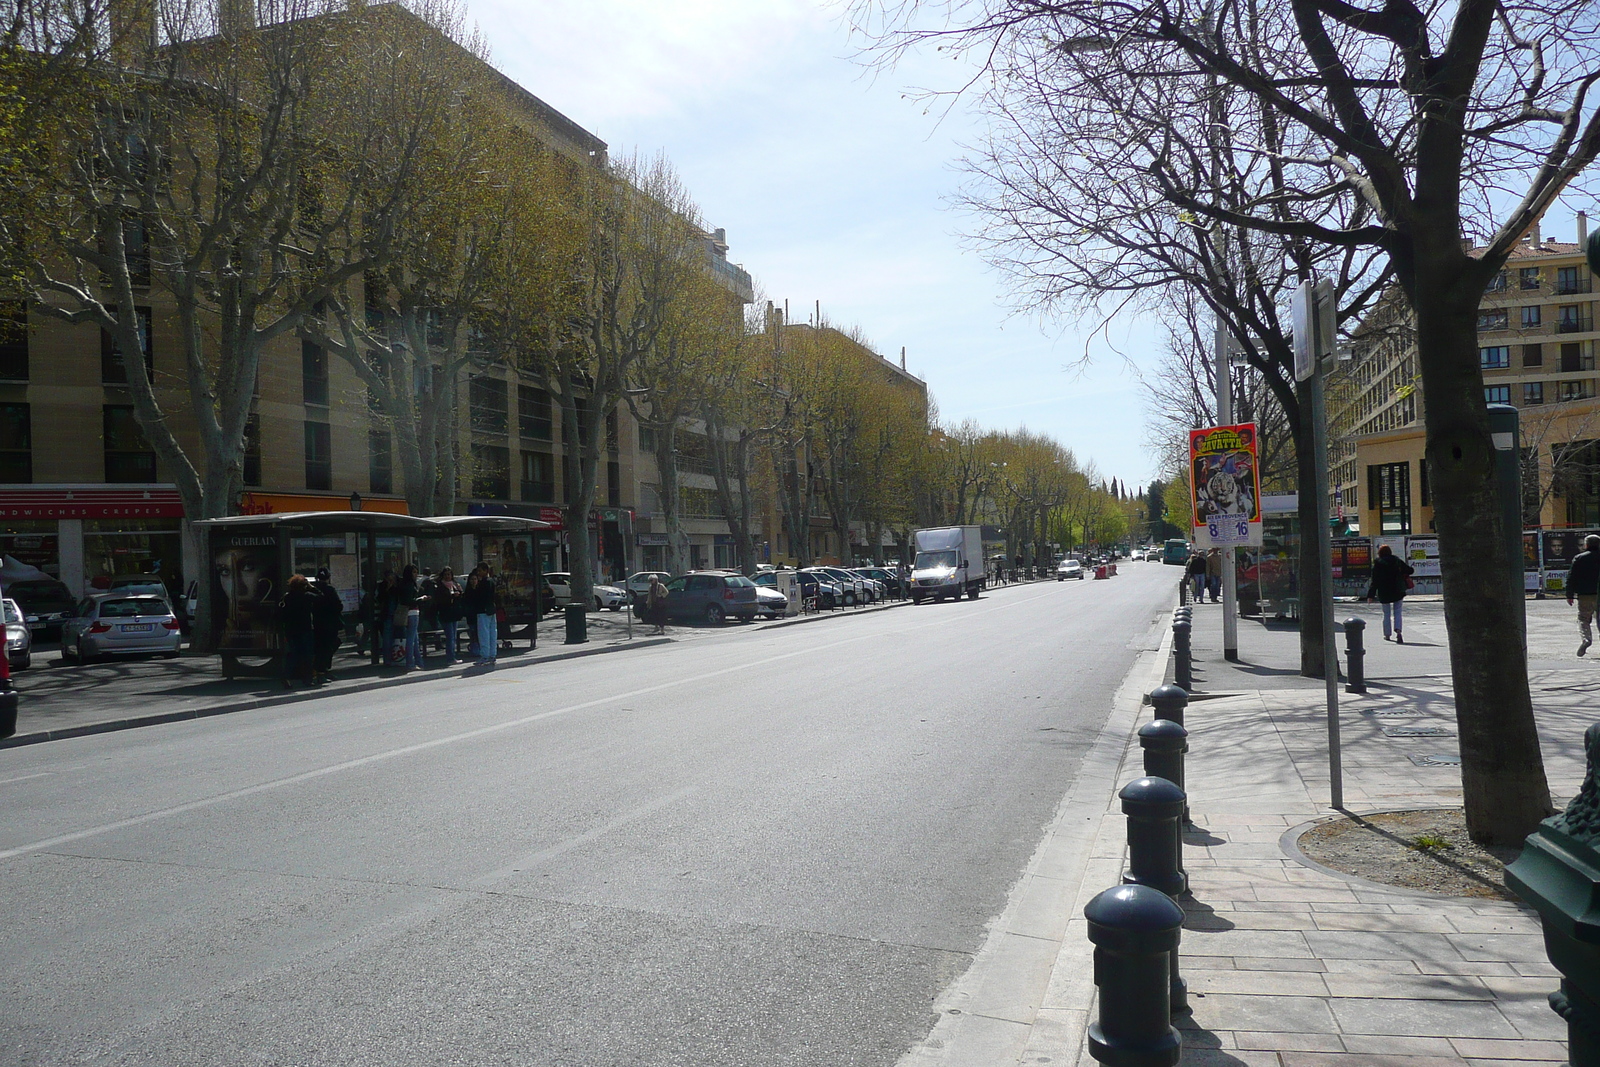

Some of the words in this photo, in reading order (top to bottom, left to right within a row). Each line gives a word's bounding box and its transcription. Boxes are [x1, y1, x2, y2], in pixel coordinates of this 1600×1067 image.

[1201, 438, 1242, 452] ZAVATTA
[1208, 523, 1218, 537] 8
[1235, 521, 1248, 536] 16
[231, 536, 276, 547] GUERLAIN
[258, 577, 275, 604] 2
